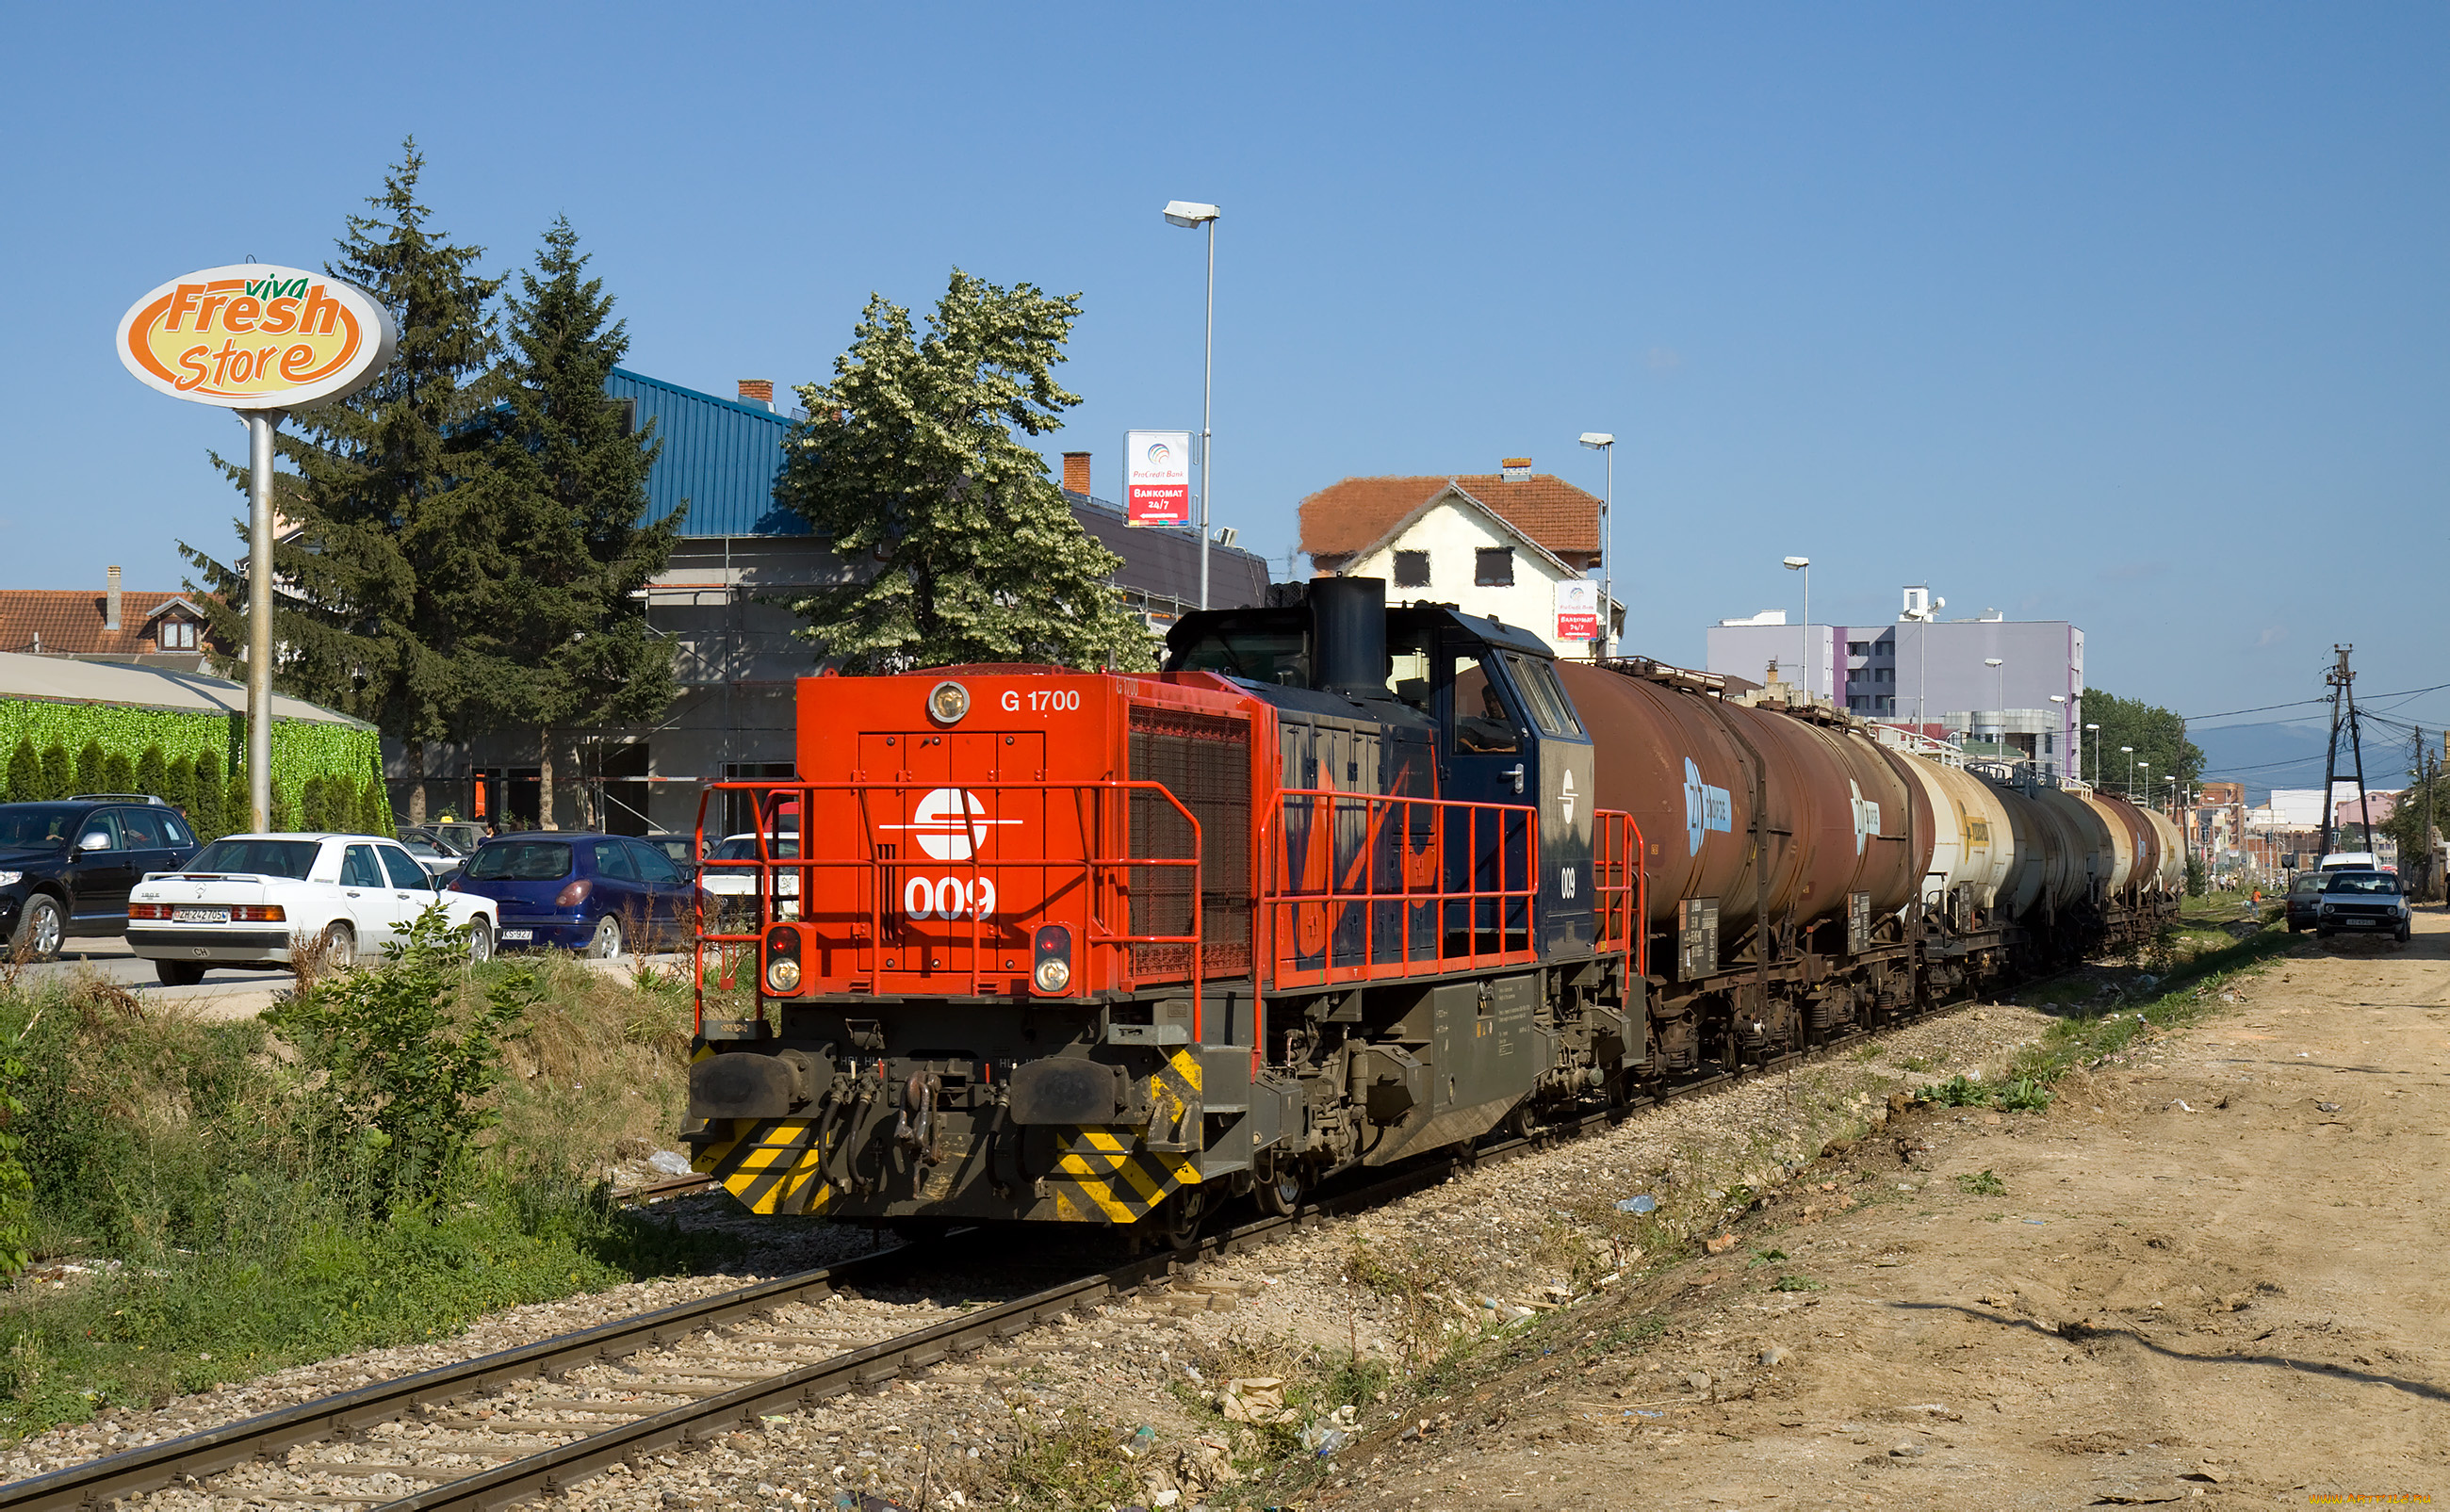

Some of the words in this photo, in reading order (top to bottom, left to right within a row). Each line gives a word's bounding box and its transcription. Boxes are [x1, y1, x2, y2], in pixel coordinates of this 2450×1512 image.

[246, 273, 309, 301] viva
[164, 284, 341, 334] Fresh
[1148, 499, 1169, 510] 24/7
[1116, 676, 1122, 694] G
[1123, 678, 1139, 696] 1700
[1001, 691, 1020, 711] G
[1027, 690, 1080, 711] 1700
[1560, 867, 1576, 900] 009
[904, 876, 996, 920] 009
[193, 948, 208, 956] CH
